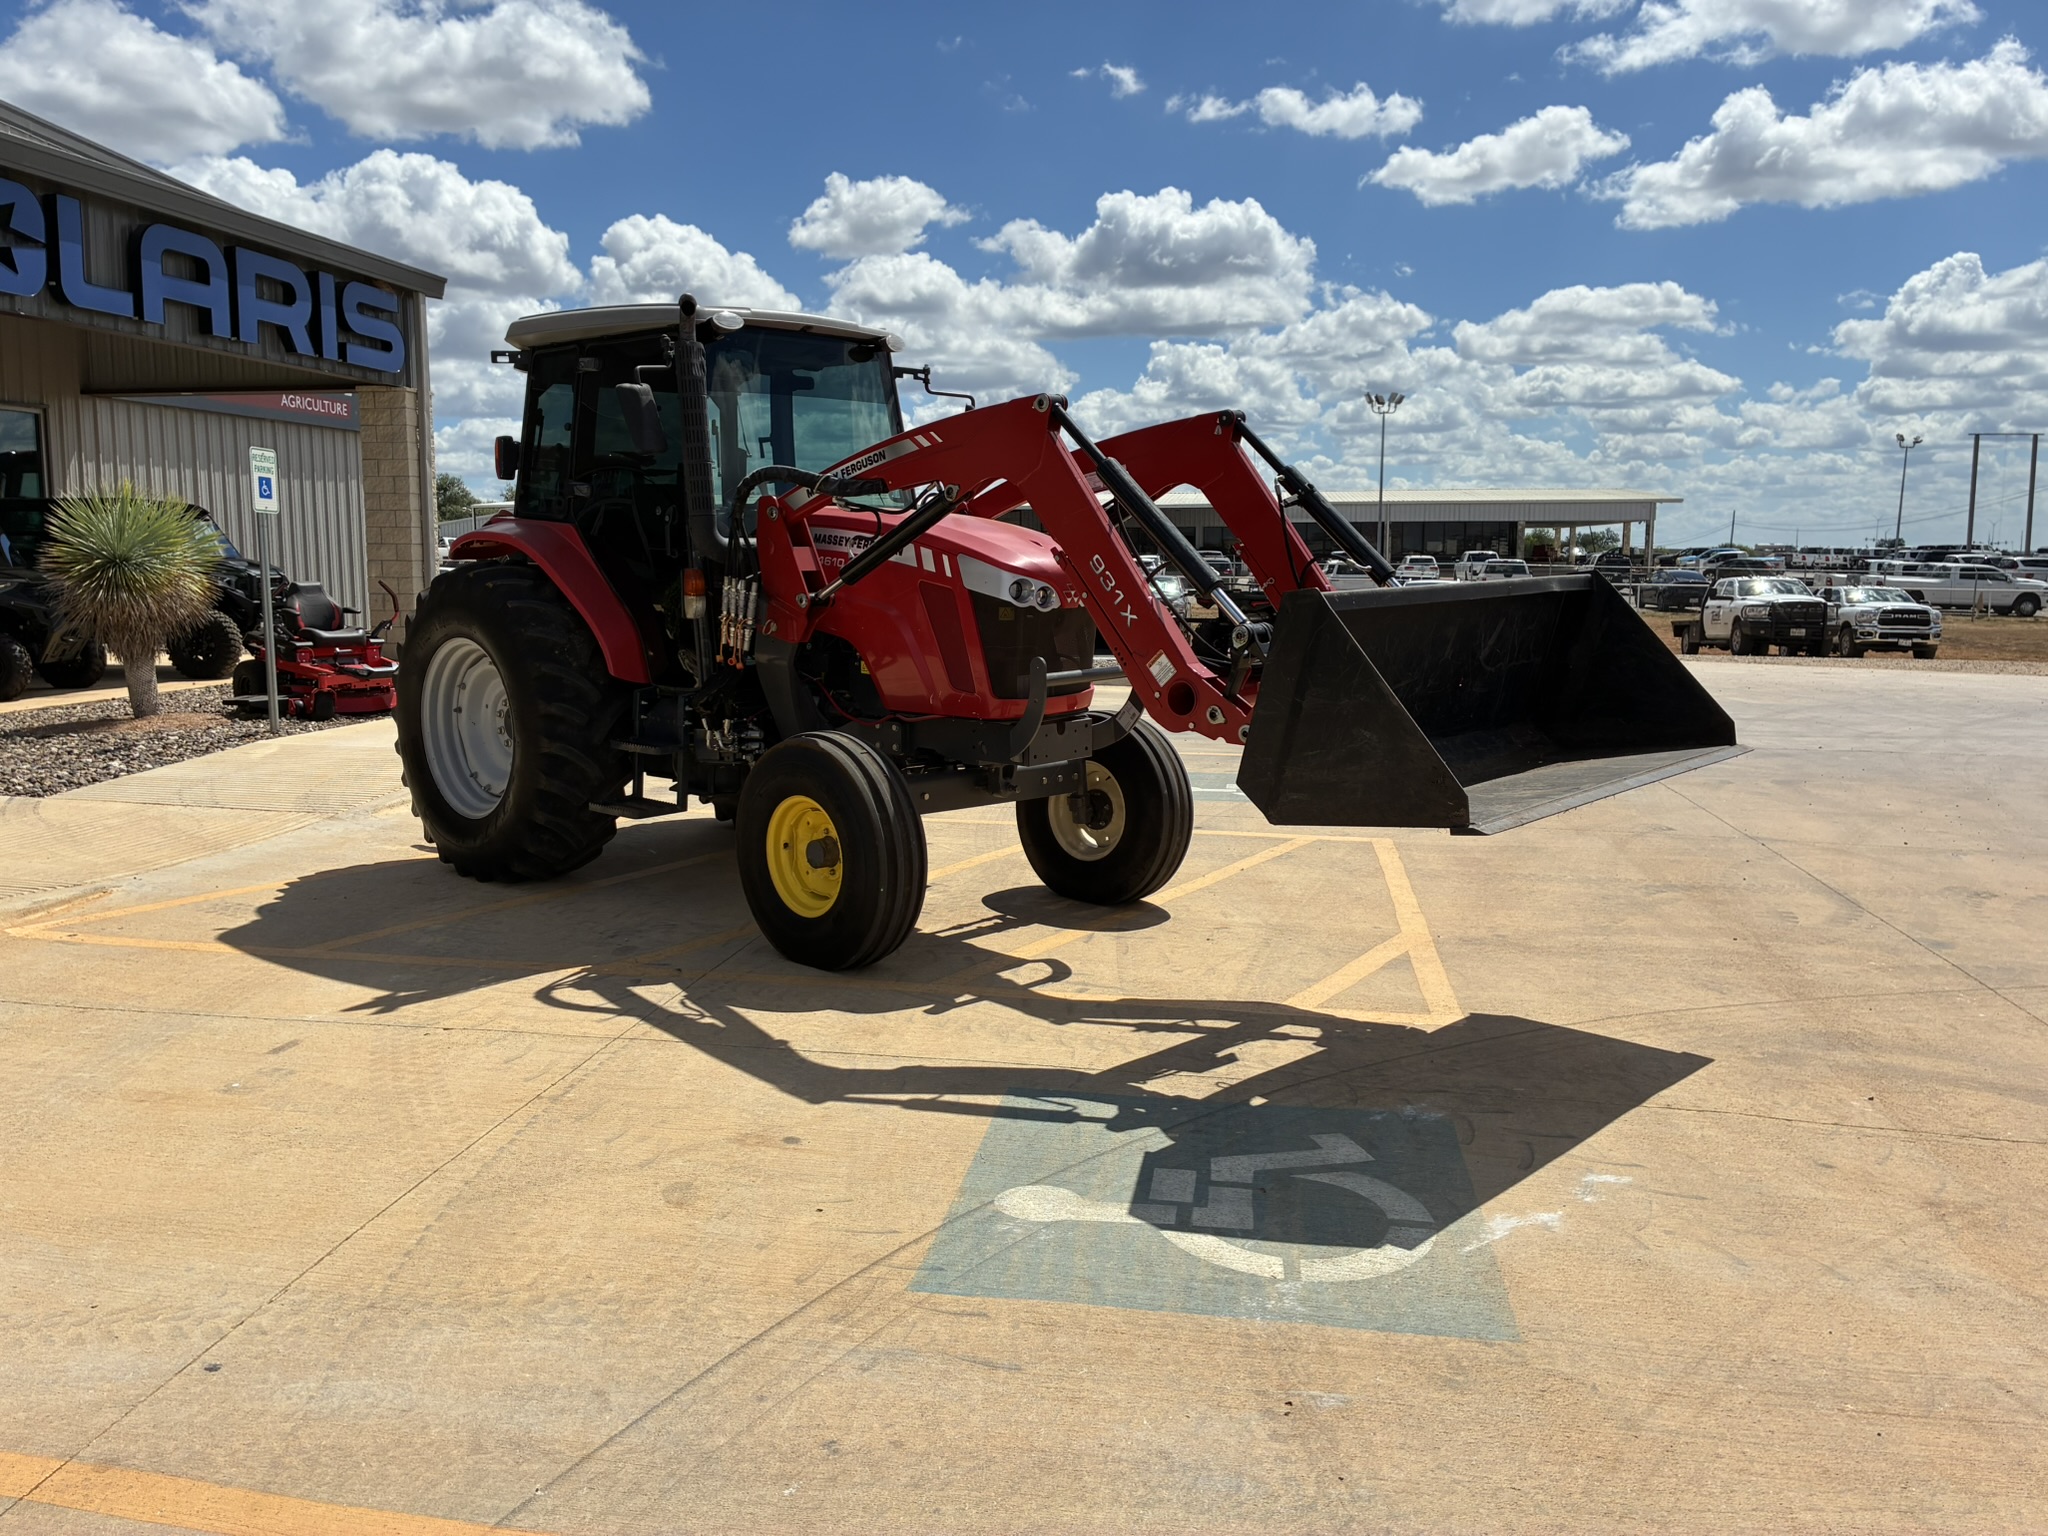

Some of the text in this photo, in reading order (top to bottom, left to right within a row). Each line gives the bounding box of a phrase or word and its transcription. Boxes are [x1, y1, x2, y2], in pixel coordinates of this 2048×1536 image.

[281, 393, 348, 416] AGRICULTURE
[254, 464, 274, 475] PARKING
[840, 449, 887, 479] FERGUSON
[814, 533, 850, 547] MASSEY
[1090, 554, 1138, 628] 931X
